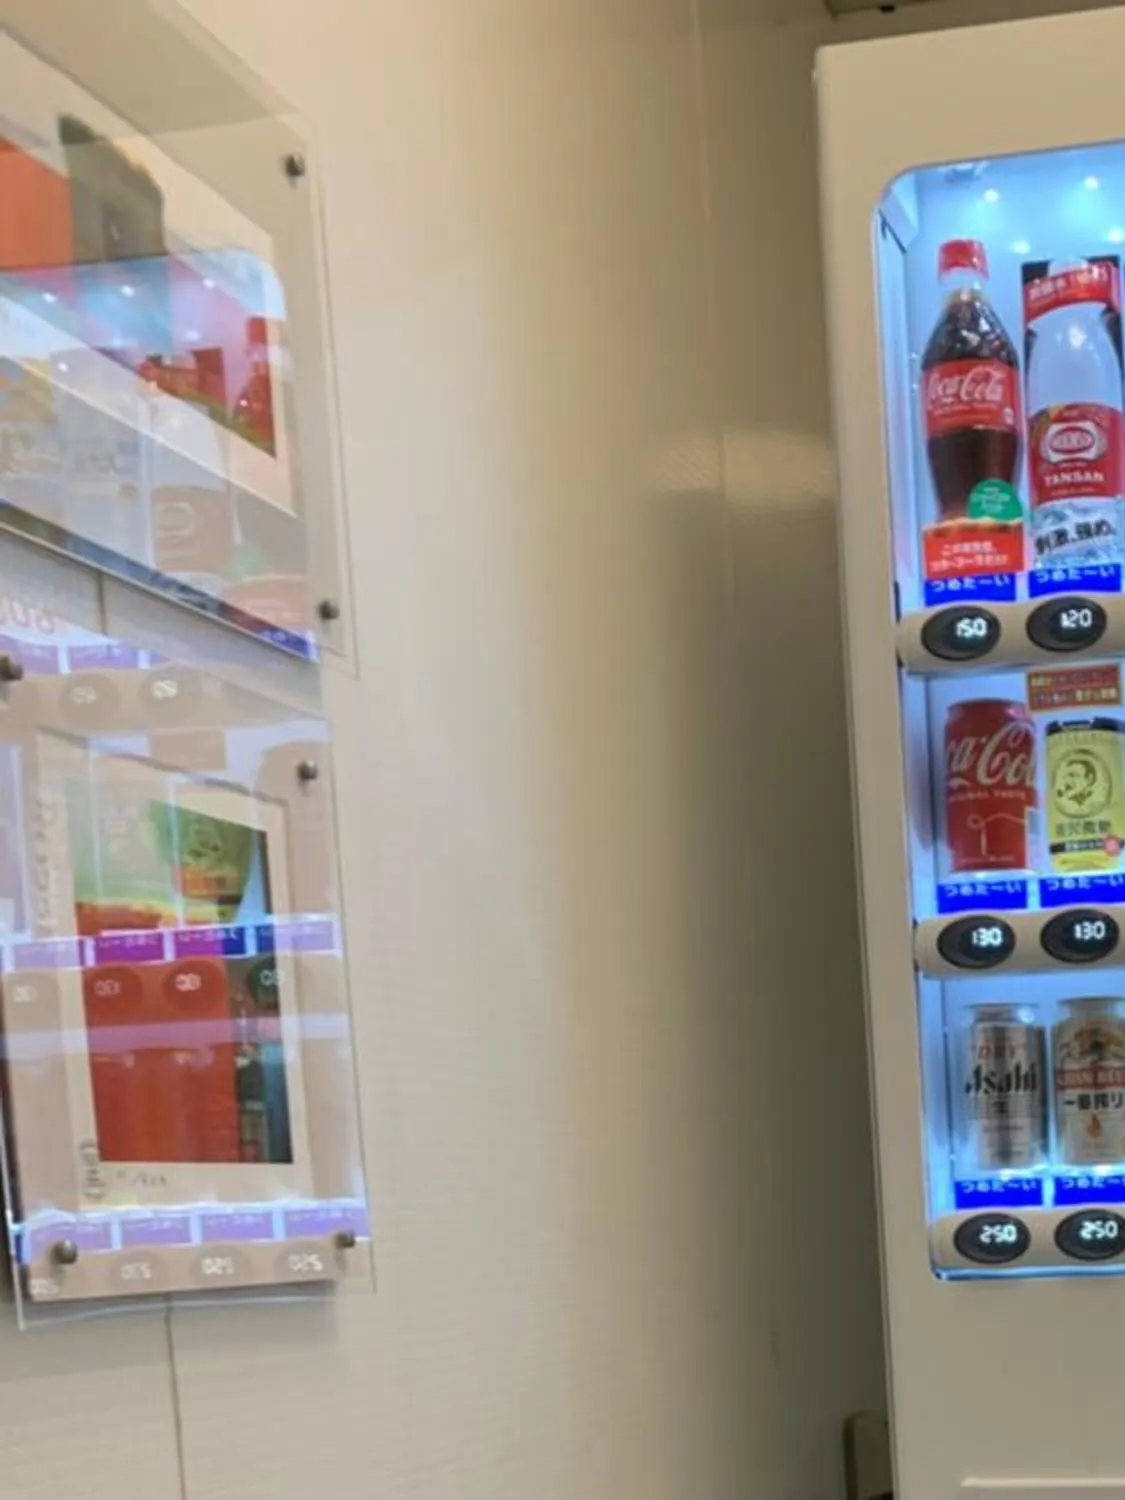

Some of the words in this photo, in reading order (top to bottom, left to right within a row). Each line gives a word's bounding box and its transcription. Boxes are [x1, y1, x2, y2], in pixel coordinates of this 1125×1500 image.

[956, 617, 987, 638] 150
[1061, 608, 1092, 628] 120
[972, 927, 1003, 947] 130
[1075, 920, 1105, 940] 130
[964, 1062, 1038, 1095] Asahi
[979, 1224, 1017, 1243] 250
[1080, 1220, 1118, 1240] 250
